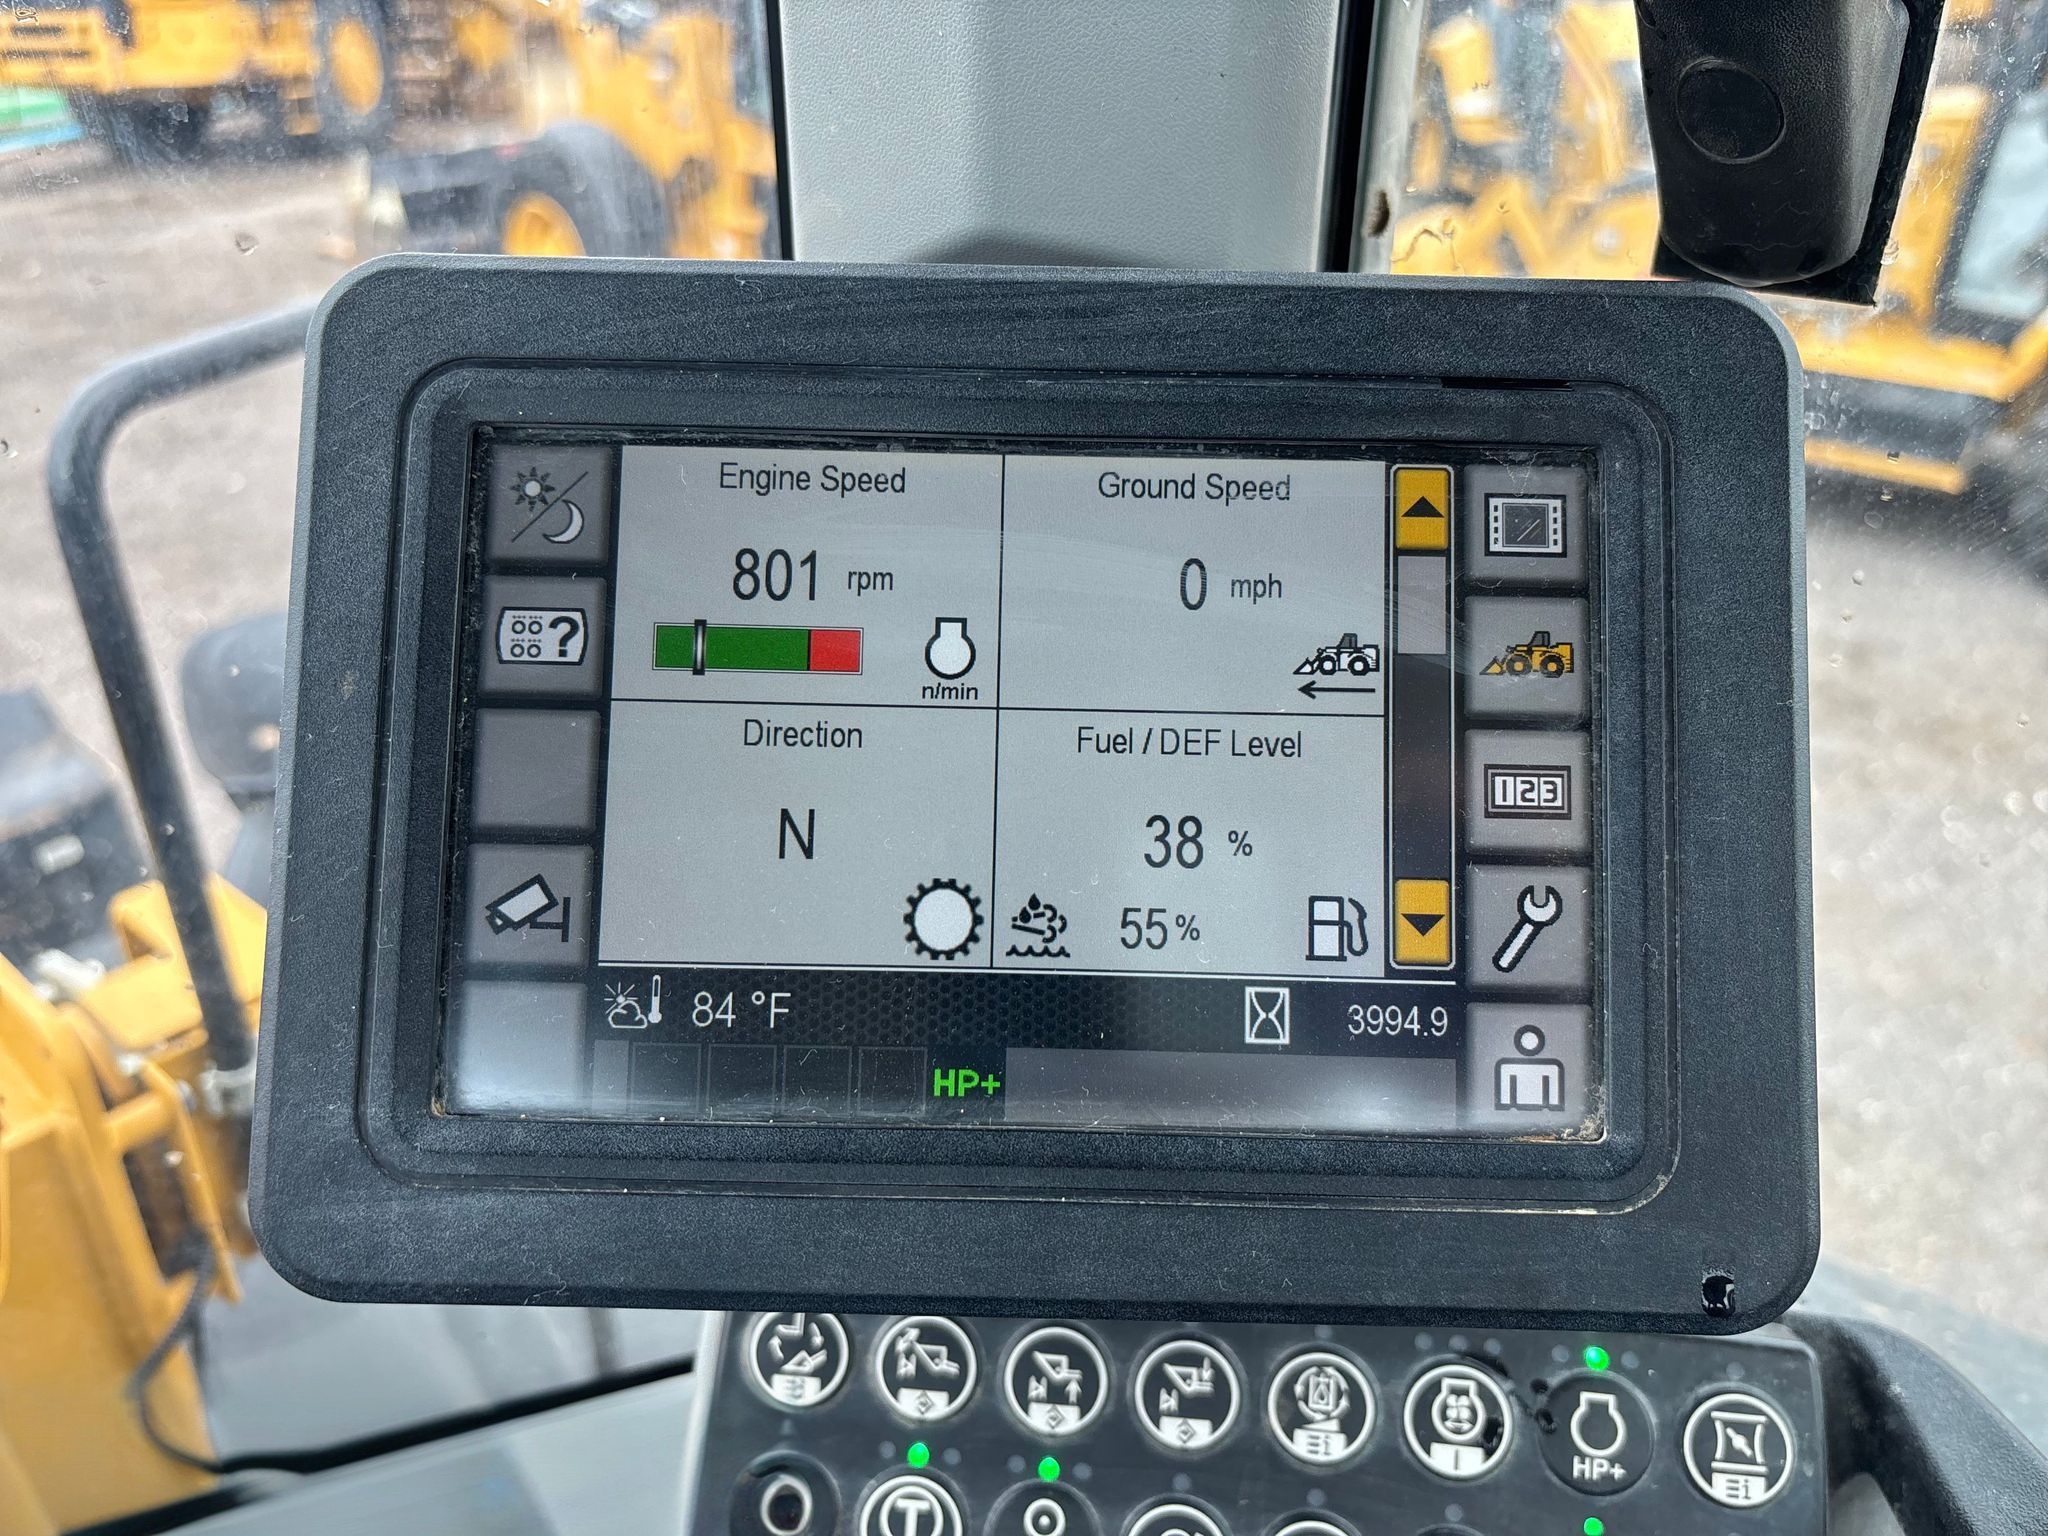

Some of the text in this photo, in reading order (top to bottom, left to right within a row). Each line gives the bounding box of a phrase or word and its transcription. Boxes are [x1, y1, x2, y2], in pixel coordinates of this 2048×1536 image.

[720, 462, 906, 499] Engine Speed
[1098, 471, 1291, 507] Ground Speed
[732, 547, 895, 602] 801 rpm
[1179, 557, 1283, 611] 0 mph
[921, 683, 979, 701] n/min
[743, 719, 863, 748] Direction
[1076, 726, 1302, 759] Fuel / DEF Level
[1494, 776, 1564, 807] 123
[778, 808, 816, 860] N
[1143, 815, 1254, 869] 38 %
[1119, 906, 1201, 949] 55 %
[691, 990, 792, 1029] 84 °F
[1346, 1004, 1449, 1037] 3994.9
[933, 1069, 1001, 1097] HP+
[1571, 1455, 1627, 1481] HP+
